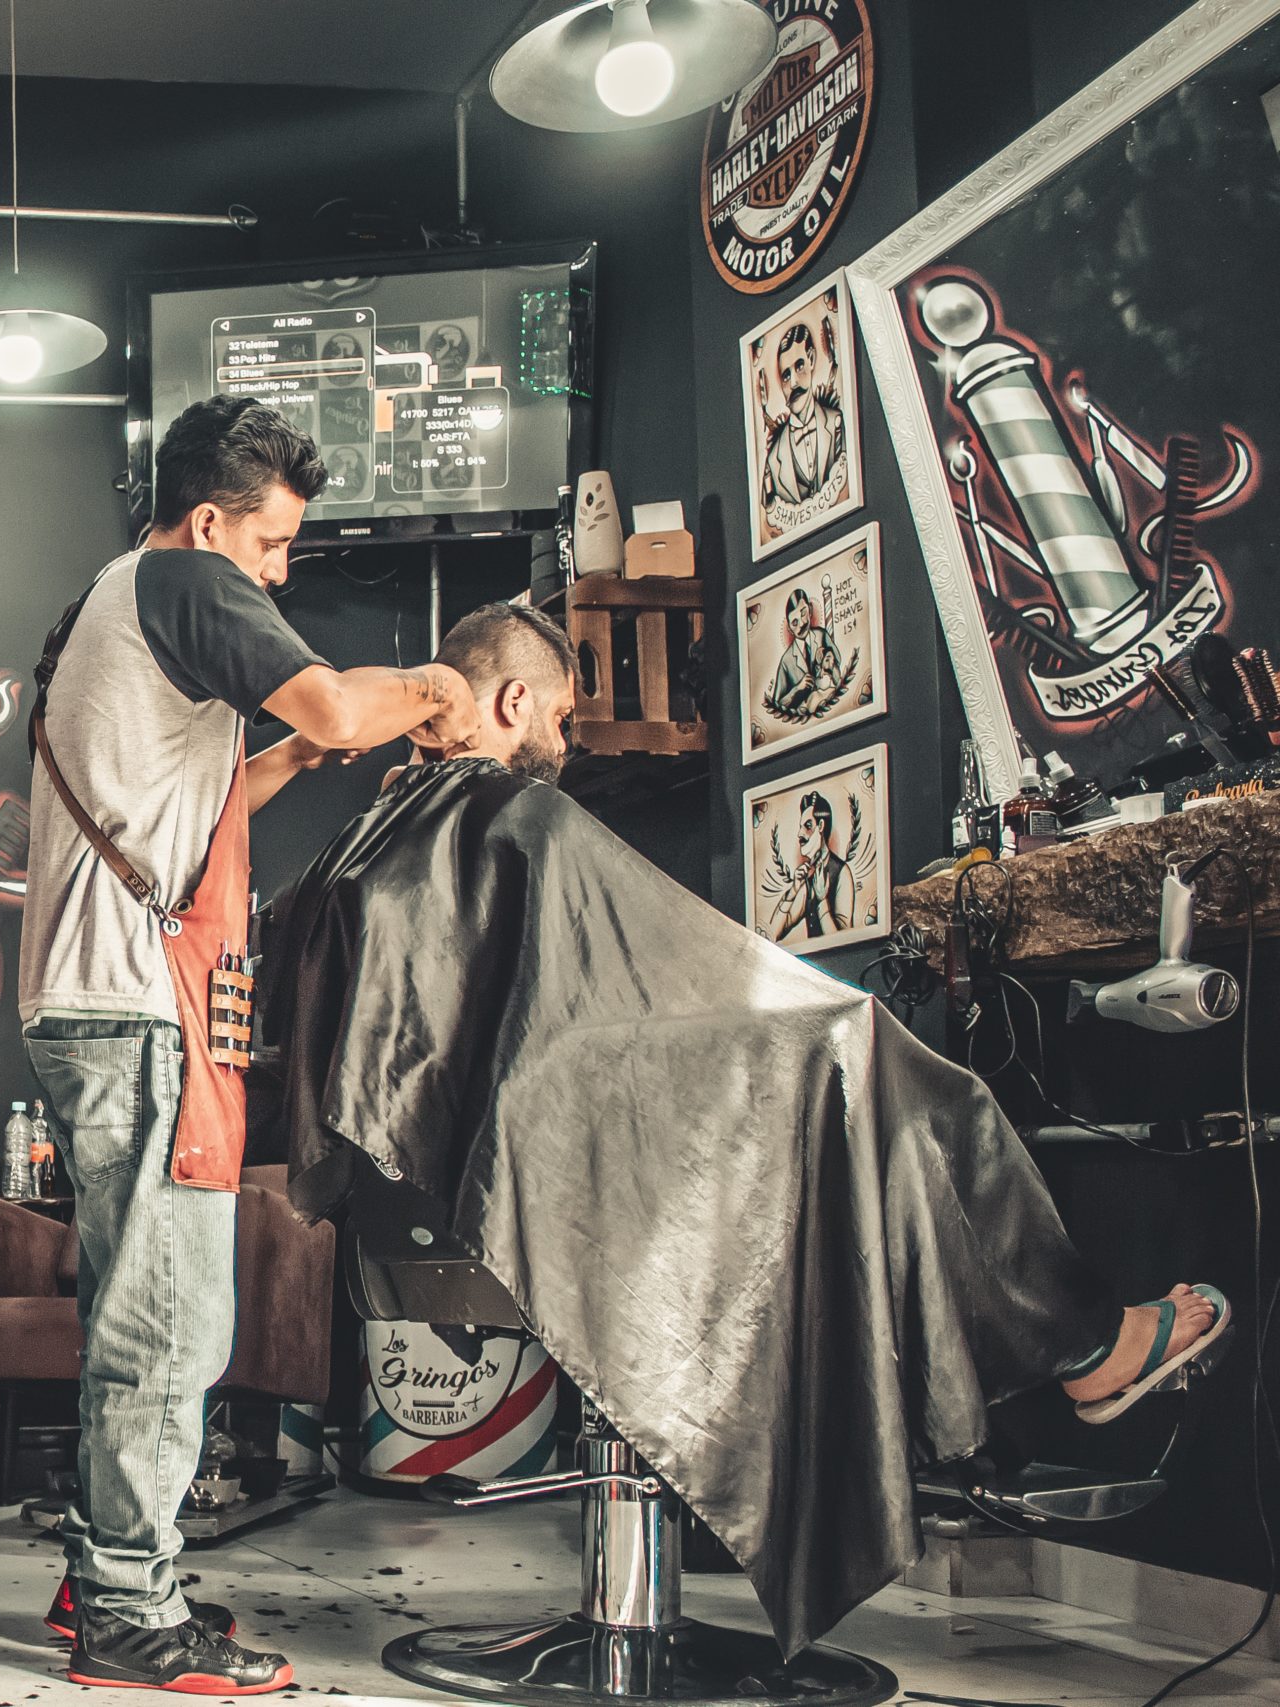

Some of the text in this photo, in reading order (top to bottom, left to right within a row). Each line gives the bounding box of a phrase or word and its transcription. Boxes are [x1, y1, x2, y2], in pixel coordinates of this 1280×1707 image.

[750, 55, 812, 123] MOTOR
[712, 52, 858, 206] HARLEY-DAVIDSON
[712, 102, 858, 228] TRADE MARK
[753, 140, 813, 202] CYCLES
[723, 155, 850, 277] MOTOR OIL
[759, 192, 809, 236] FINEST QUALITY
[273, 317, 313, 328] All Radio
[228, 341, 239, 351] 32
[228, 353, 276, 365] 33 Pop Hits
[228, 369, 264, 379] 34 Blues
[228, 381, 299, 394] 35 Black/Hip Hop
[282, 393, 314, 403] Univers
[437, 395, 463, 404] Blues
[401, 409, 428, 419] 41700
[432, 407, 454, 417] 5217
[425, 419, 474, 430] 333(0x14D)
[429, 431, 471, 442] CAS:FTA
[446, 445, 463, 454] 333
[326, 476, 345, 487] A-Z)
[775, 505, 812, 526] SHAVES
[818, 469, 843, 510] CUTS
[340, 528, 371, 536] SAMSUNG
[836, 577, 853, 594] HOT
[834, 588, 858, 609] FOAM
[834, 601, 864, 623] SHAVE
[1185, 778, 1265, 801] bearia
[382, 1329, 409, 1354] Los
[379, 1357, 500, 1397] Gringos
[402, 1408, 468, 1426] BARBEARIA
